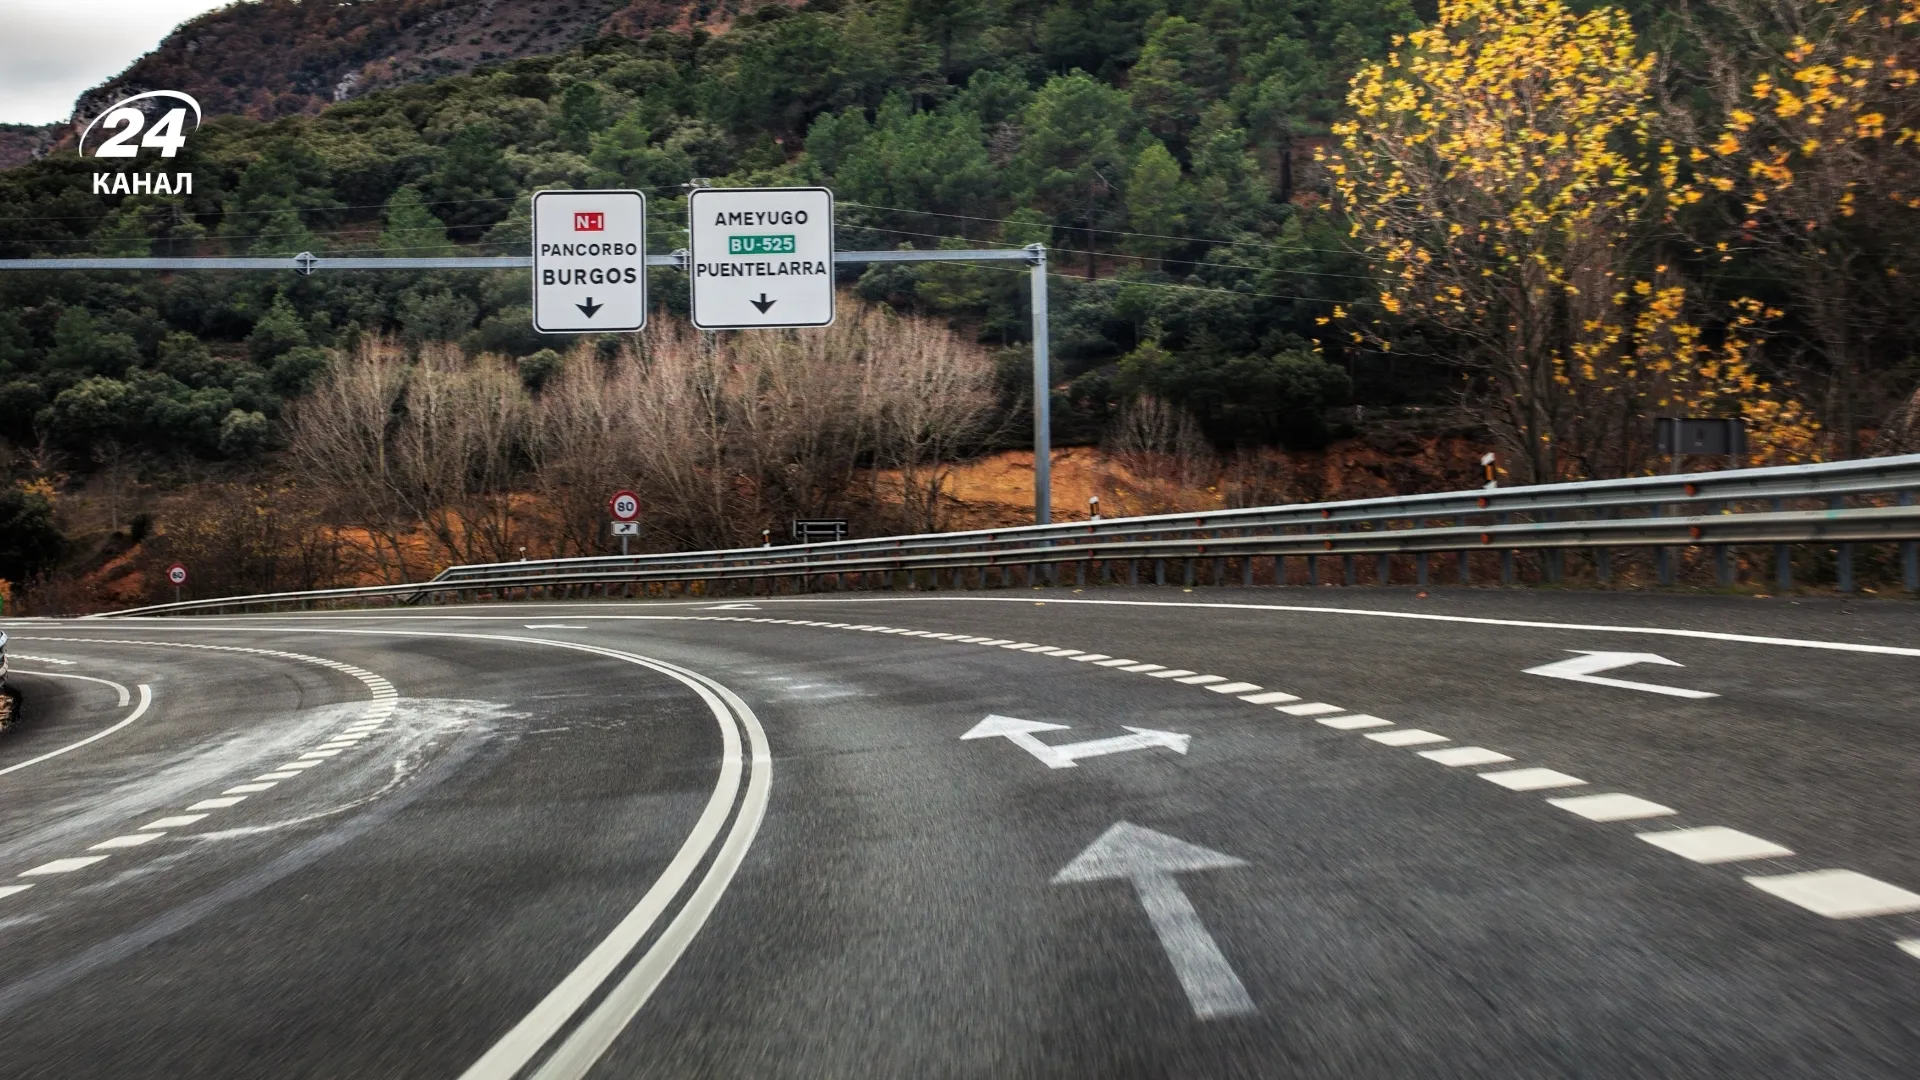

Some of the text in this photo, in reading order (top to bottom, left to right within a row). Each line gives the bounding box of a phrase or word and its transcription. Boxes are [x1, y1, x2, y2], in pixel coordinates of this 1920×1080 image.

[715, 210, 808, 226] AMEYUGO
[541, 243, 637, 256] PANCORBO
[731, 237, 793, 252] BU-525
[543, 268, 637, 285] BURGOS
[697, 261, 827, 277] PUENTELARRA
[617, 501, 635, 512] 80
